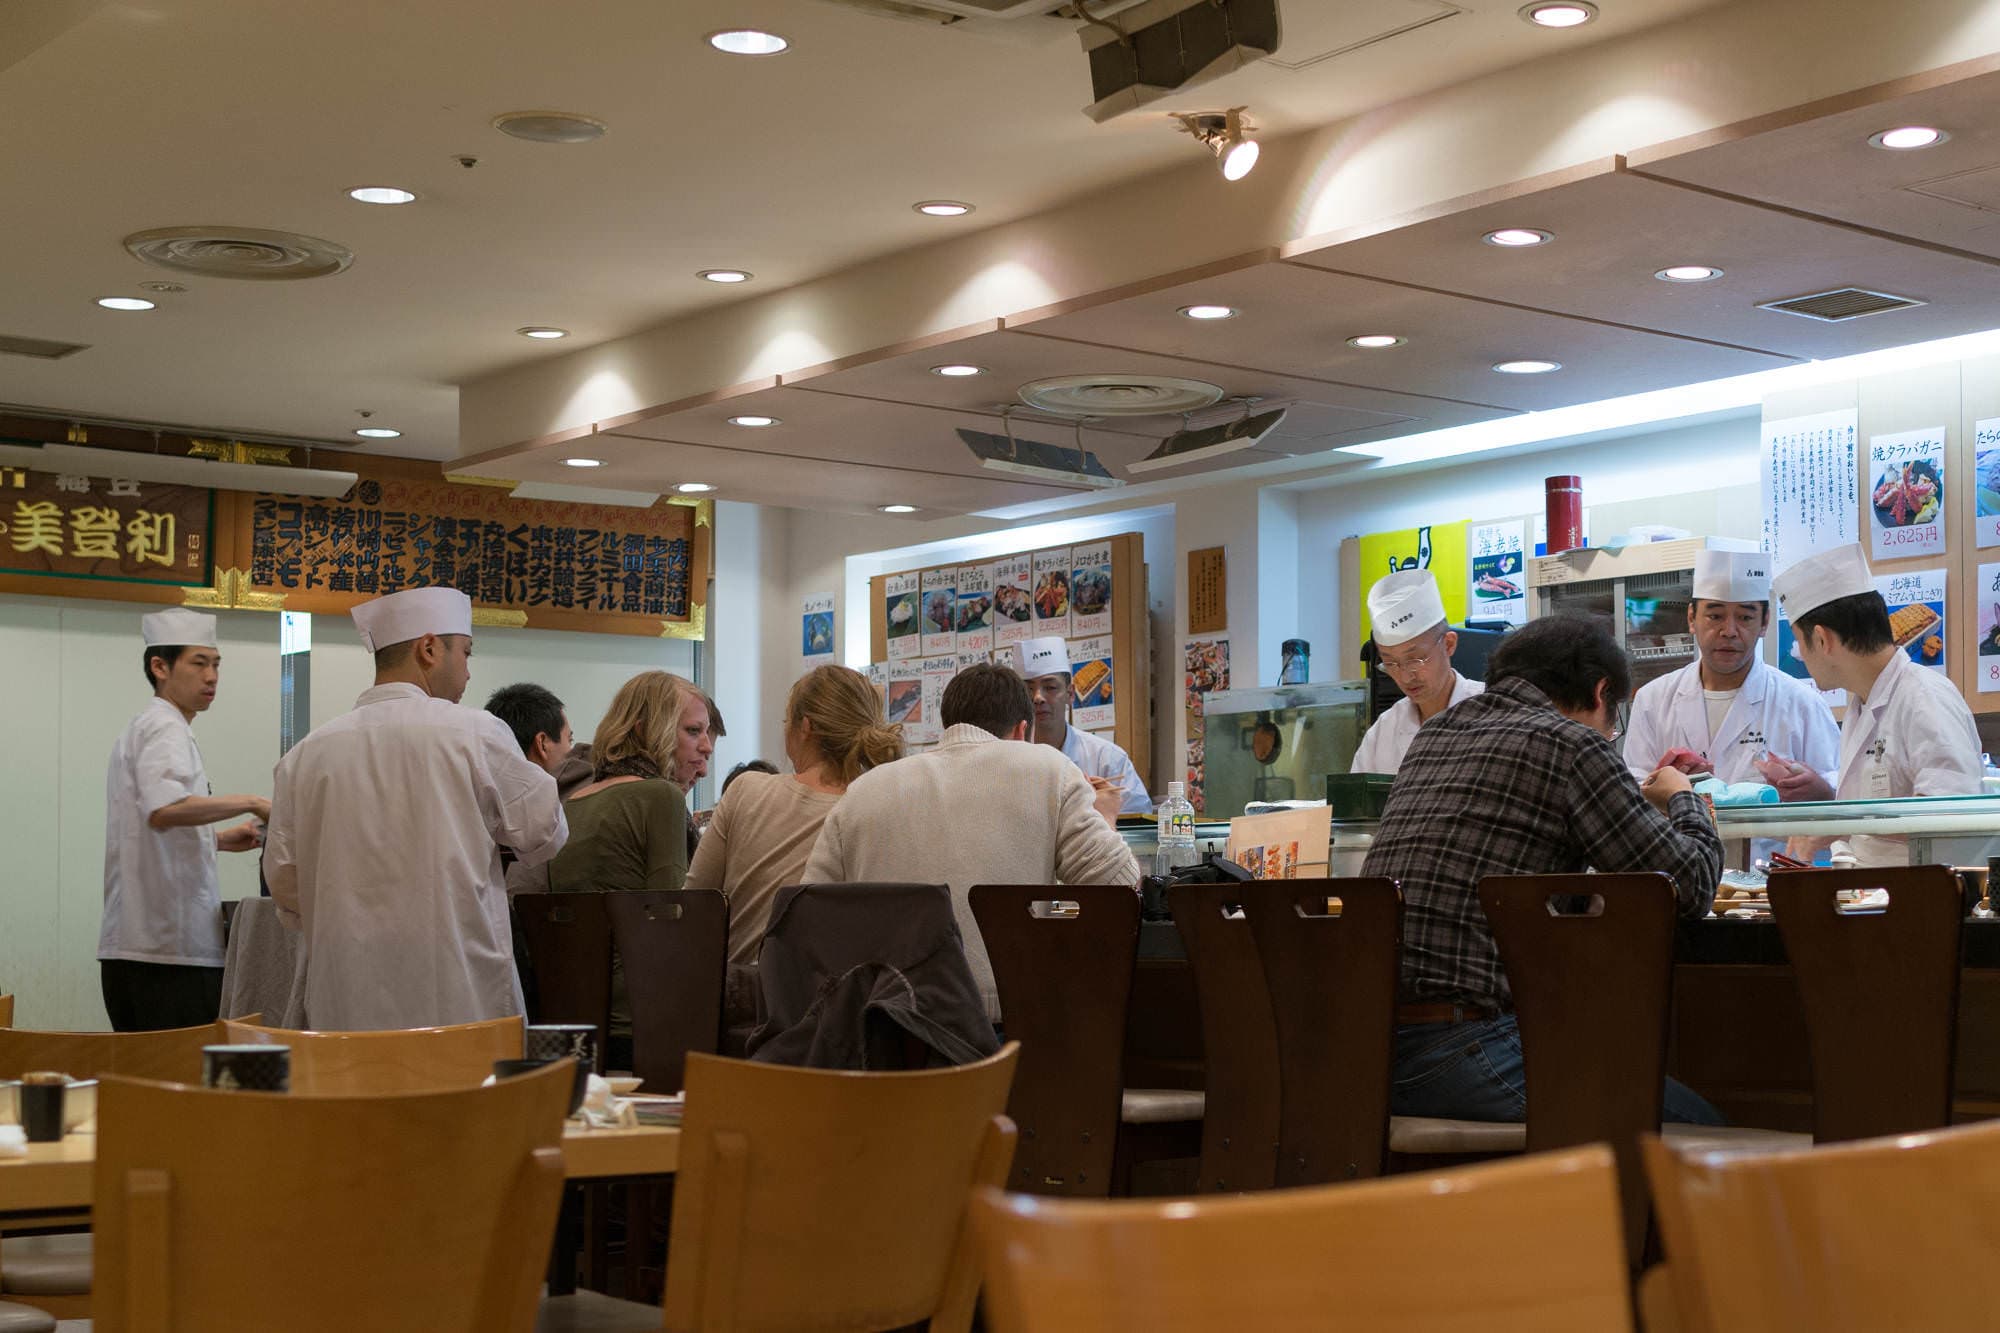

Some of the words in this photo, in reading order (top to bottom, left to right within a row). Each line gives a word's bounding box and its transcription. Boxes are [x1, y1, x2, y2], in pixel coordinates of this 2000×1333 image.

[1872, 440, 1942, 461] 焼タラバガニ
[276, 502, 303, 588] コスモ
[1883, 526, 1937, 545] 2,625円
[1890, 576, 1921, 591] 北海道
[1991, 665, 1999, 680] 8
